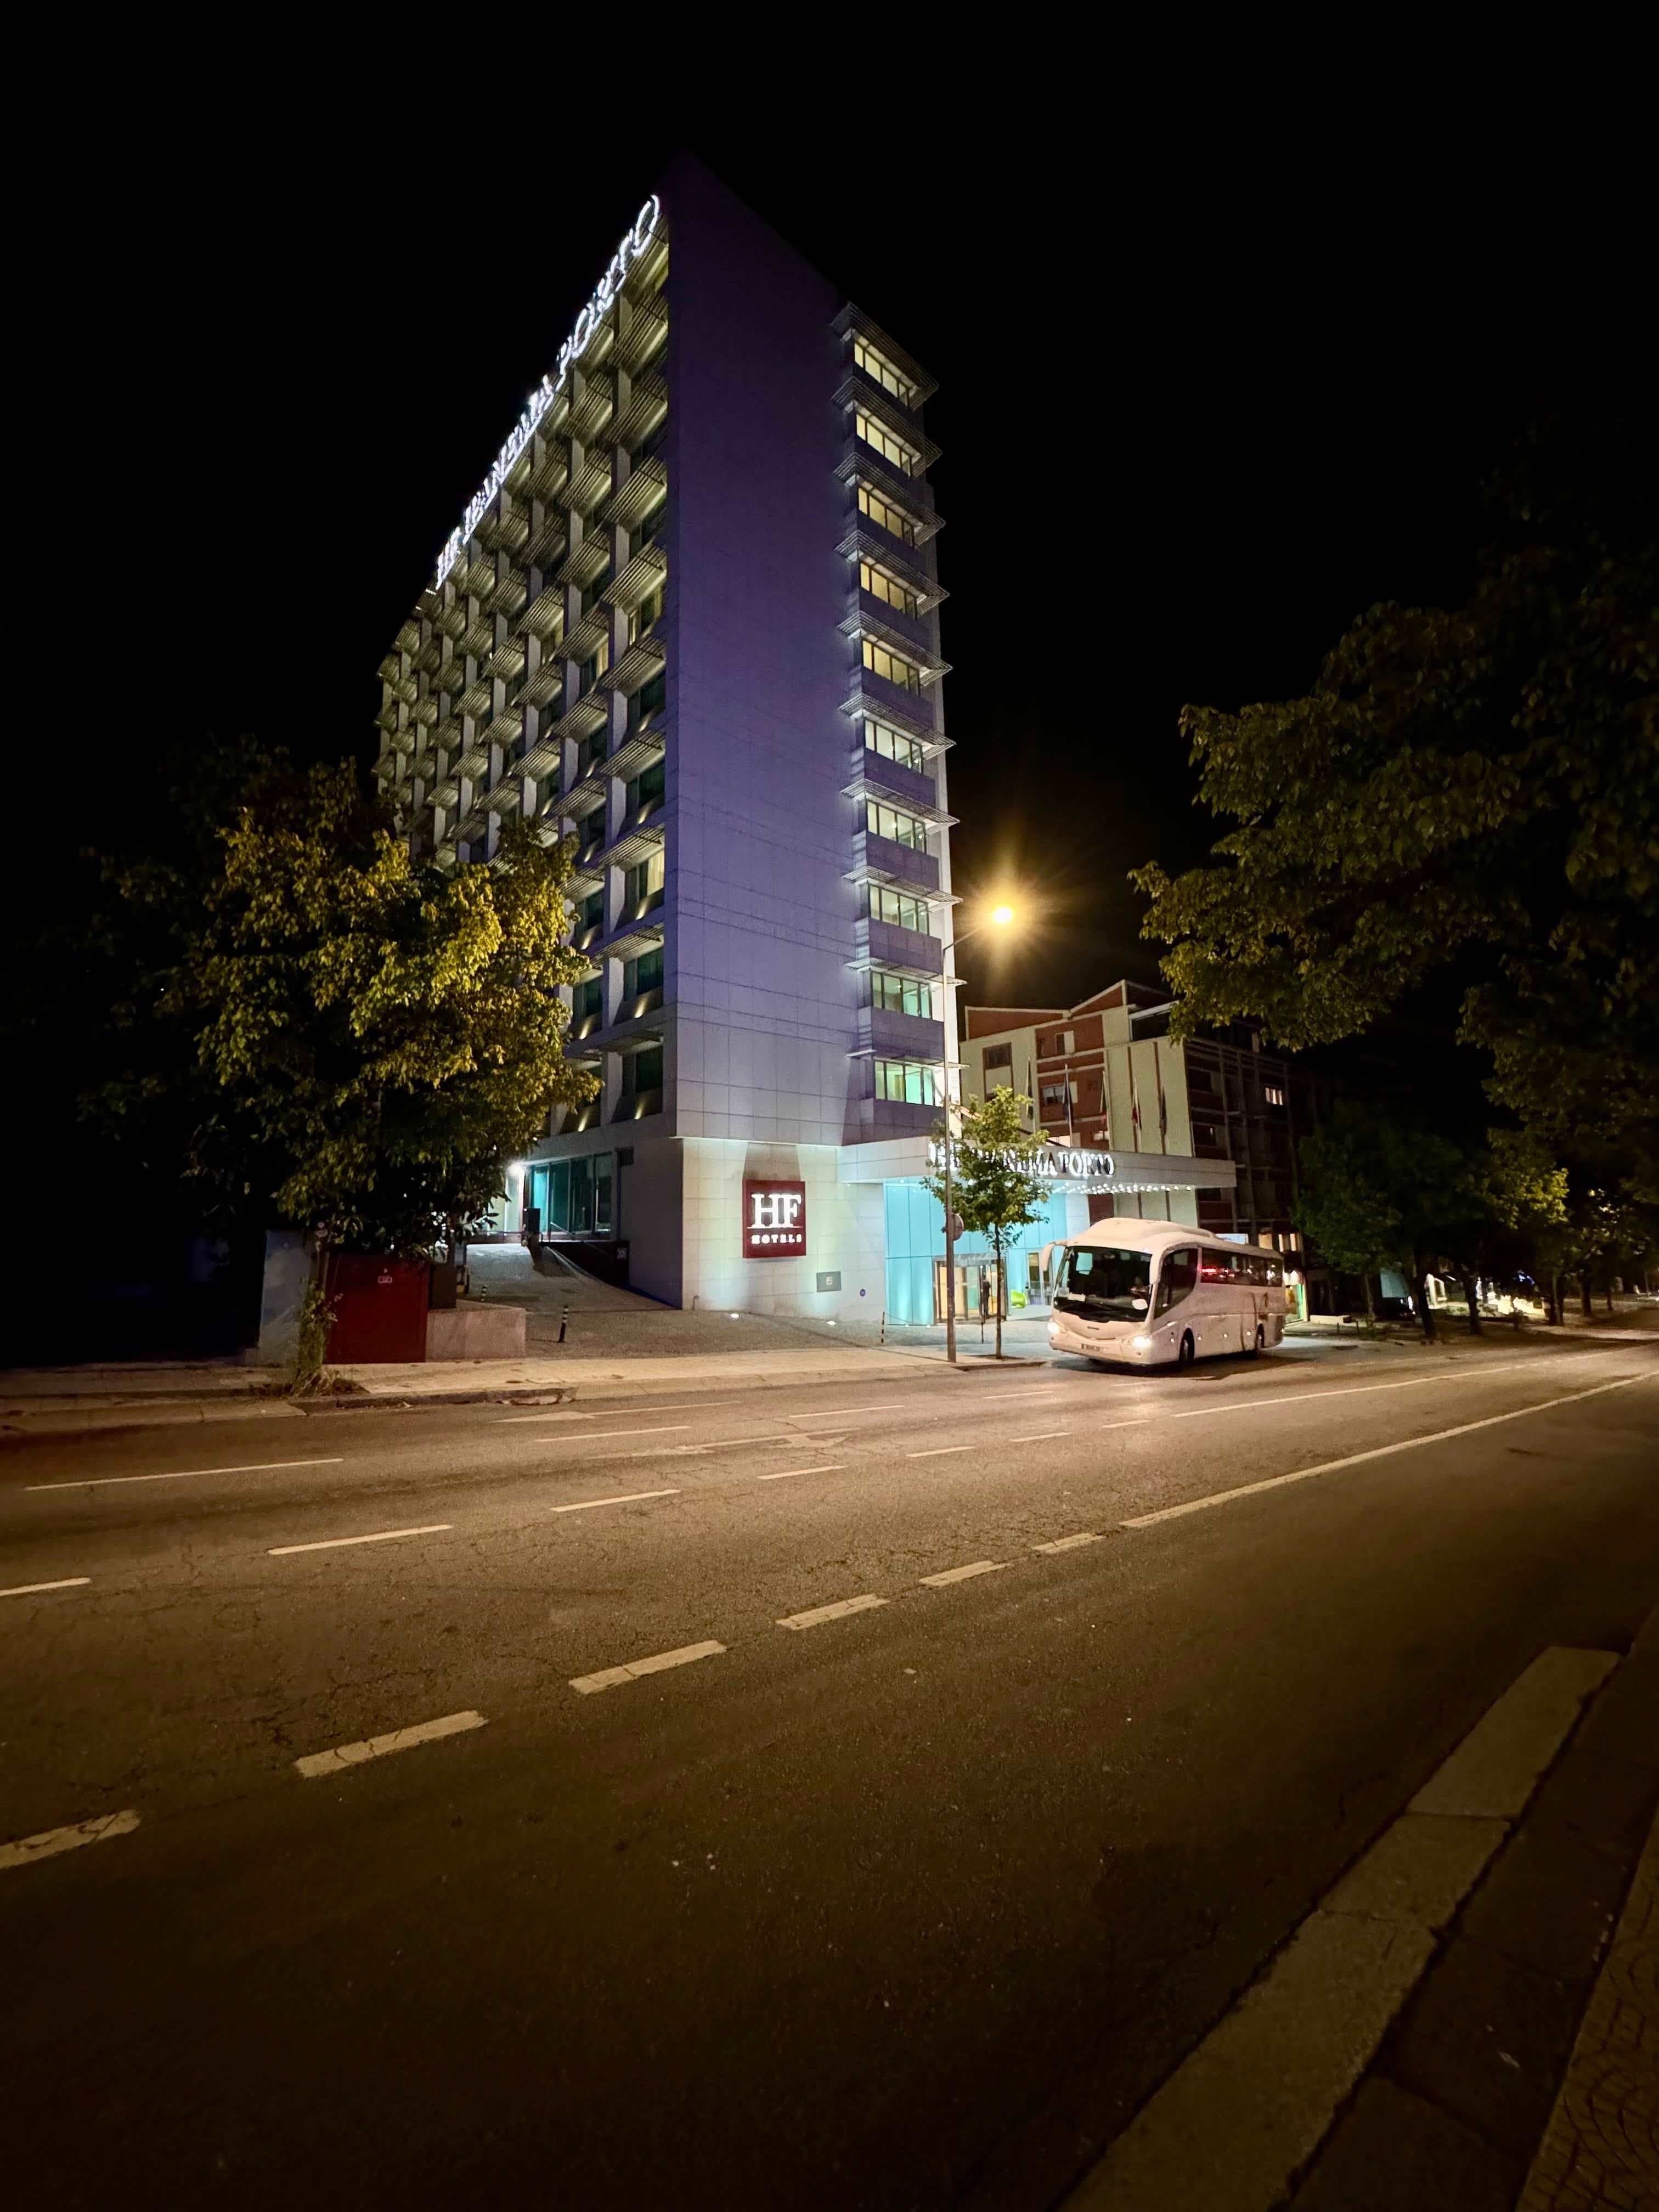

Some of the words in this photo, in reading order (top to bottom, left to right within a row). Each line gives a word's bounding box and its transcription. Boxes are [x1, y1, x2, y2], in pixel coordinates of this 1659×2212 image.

[1058, 1150, 1115, 1178] PORTO
[751, 1194, 803, 1229] HF
[751, 1233, 803, 1245] HOTELS
